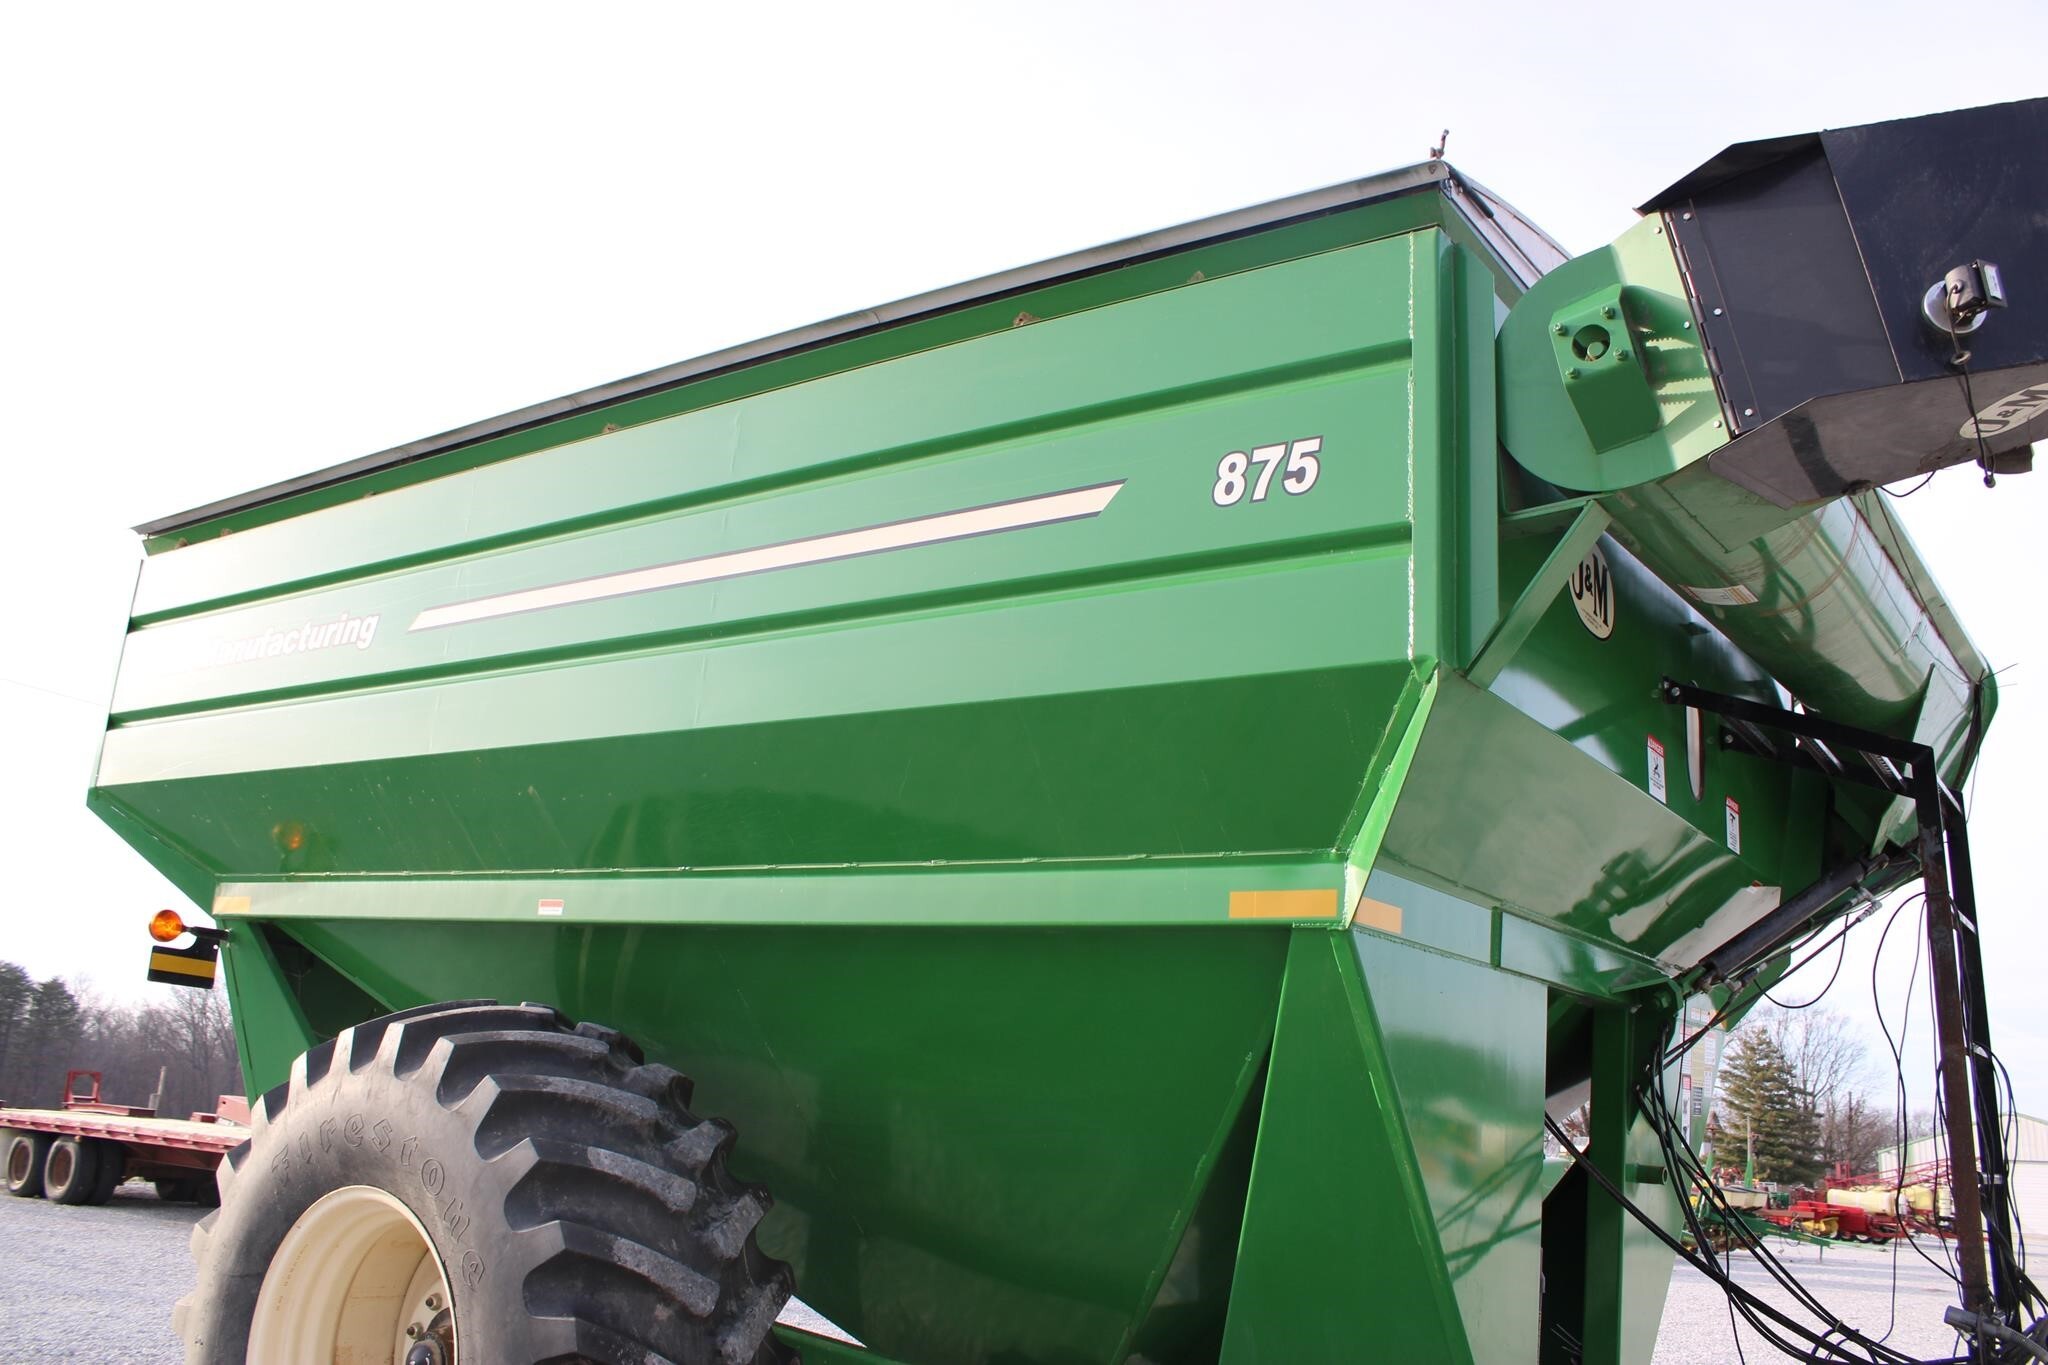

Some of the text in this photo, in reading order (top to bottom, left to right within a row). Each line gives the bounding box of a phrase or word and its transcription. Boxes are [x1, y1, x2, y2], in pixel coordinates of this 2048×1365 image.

[1970, 389, 2048, 433] J&M
[1212, 435, 1323, 507] 875
[1570, 553, 1609, 627] J&M
[205, 612, 380, 667] anufacturing
[272, 1113, 486, 1292] Firestone
